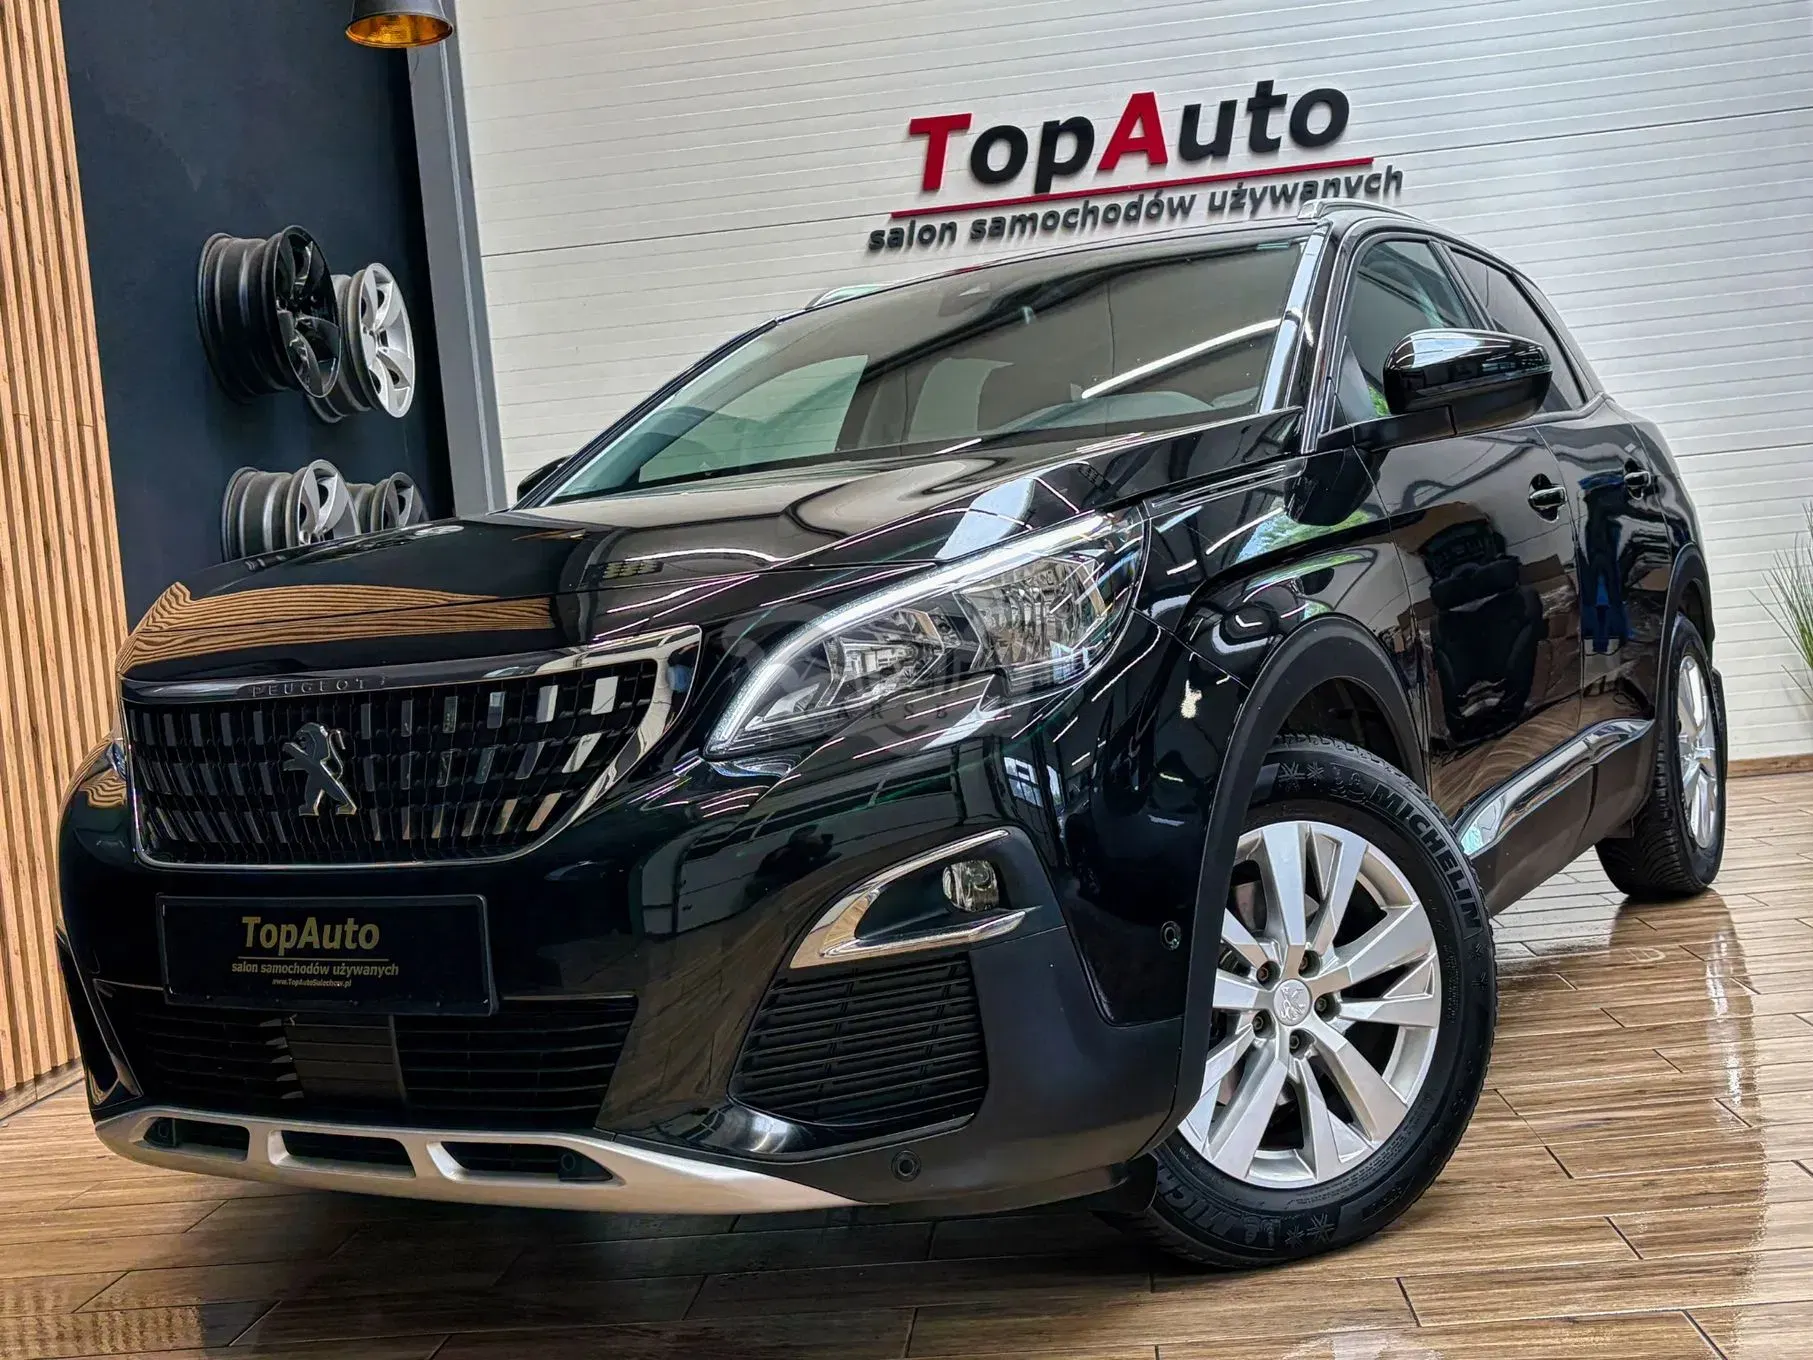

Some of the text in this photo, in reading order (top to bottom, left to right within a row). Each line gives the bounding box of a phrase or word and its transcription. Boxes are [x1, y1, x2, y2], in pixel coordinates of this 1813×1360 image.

[909, 79, 1351, 194] TopAuto
[868, 165, 1403, 252] salon samochodów używanych
[1369, 782, 1482, 929] MICHELIN
[231, 961, 399, 978] salon samochodów używanych
[242, 916, 380, 956] TopAuto
